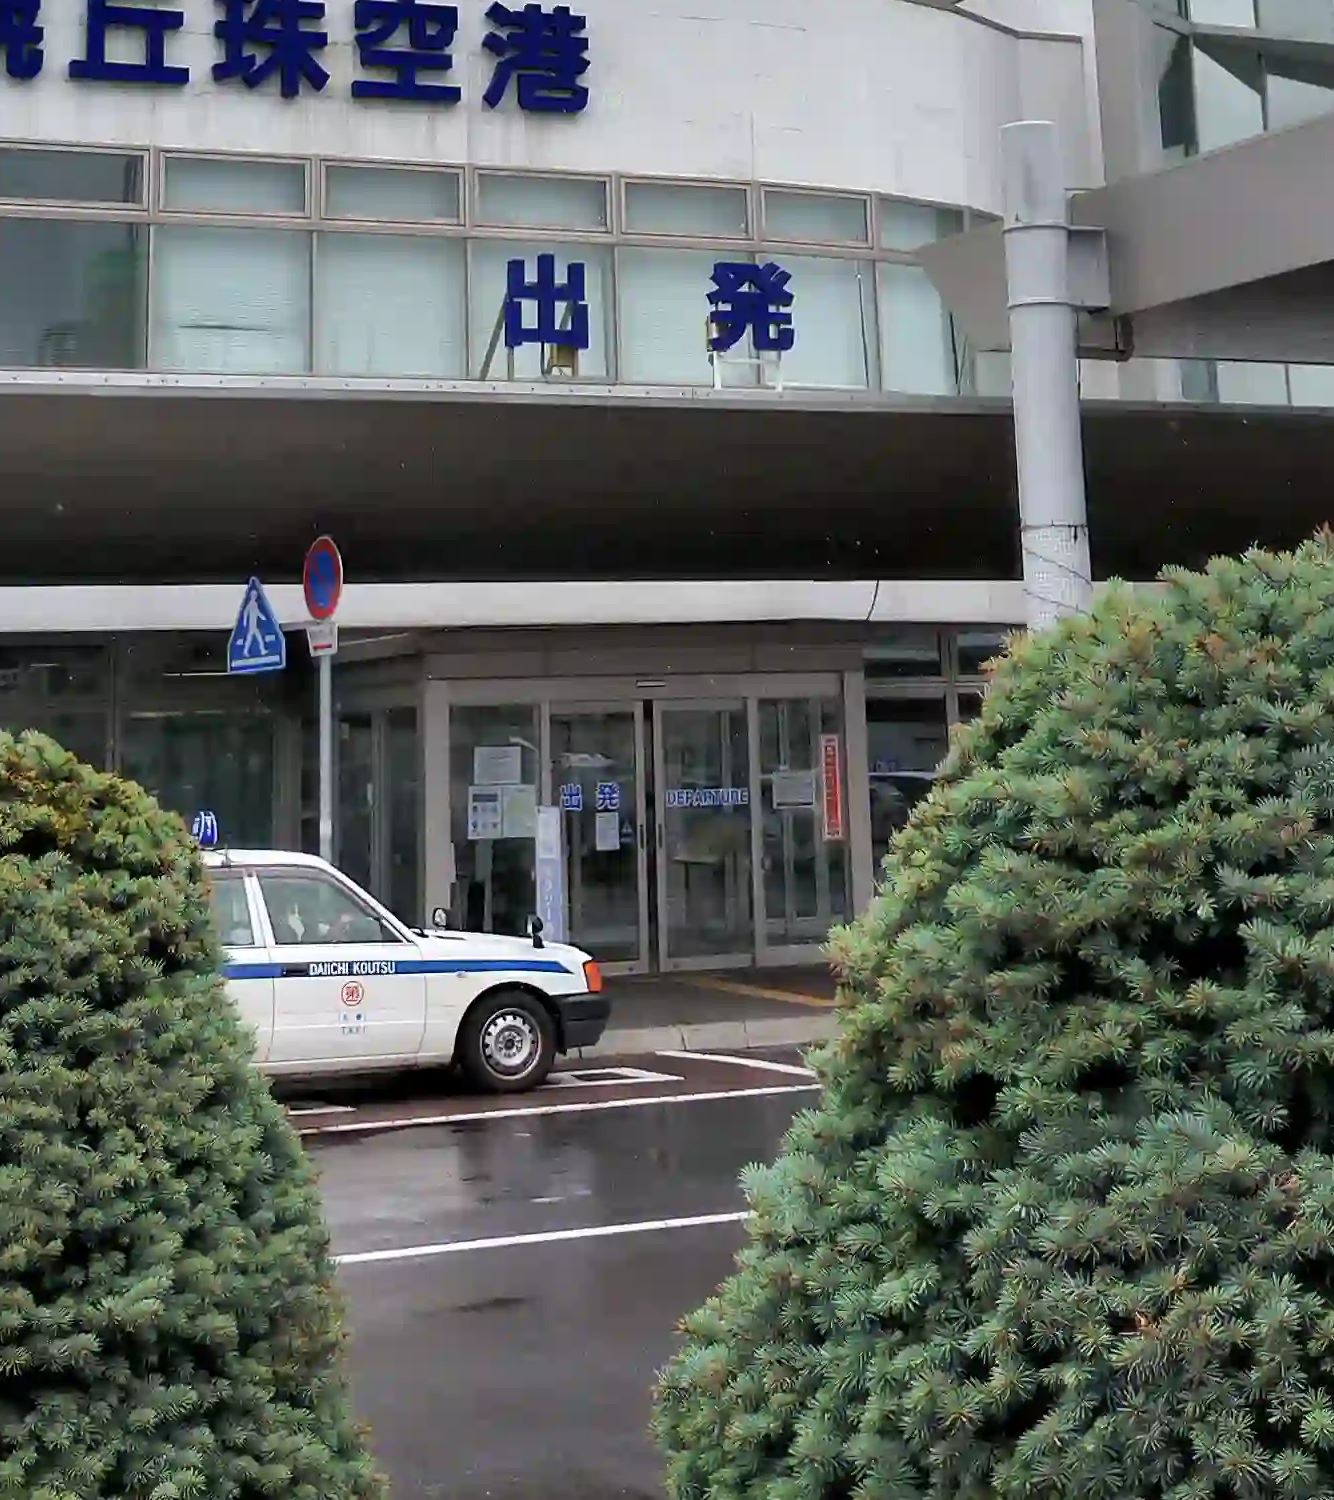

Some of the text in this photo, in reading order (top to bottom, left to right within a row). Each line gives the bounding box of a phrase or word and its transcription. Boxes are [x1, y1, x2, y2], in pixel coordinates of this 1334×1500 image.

[504, 253, 796, 352] 出発
[560, 781, 621, 812] 出発
[666, 787, 749, 808] DEPARTURE
[309, 961, 396, 976] DAIICHI KOUTSU
